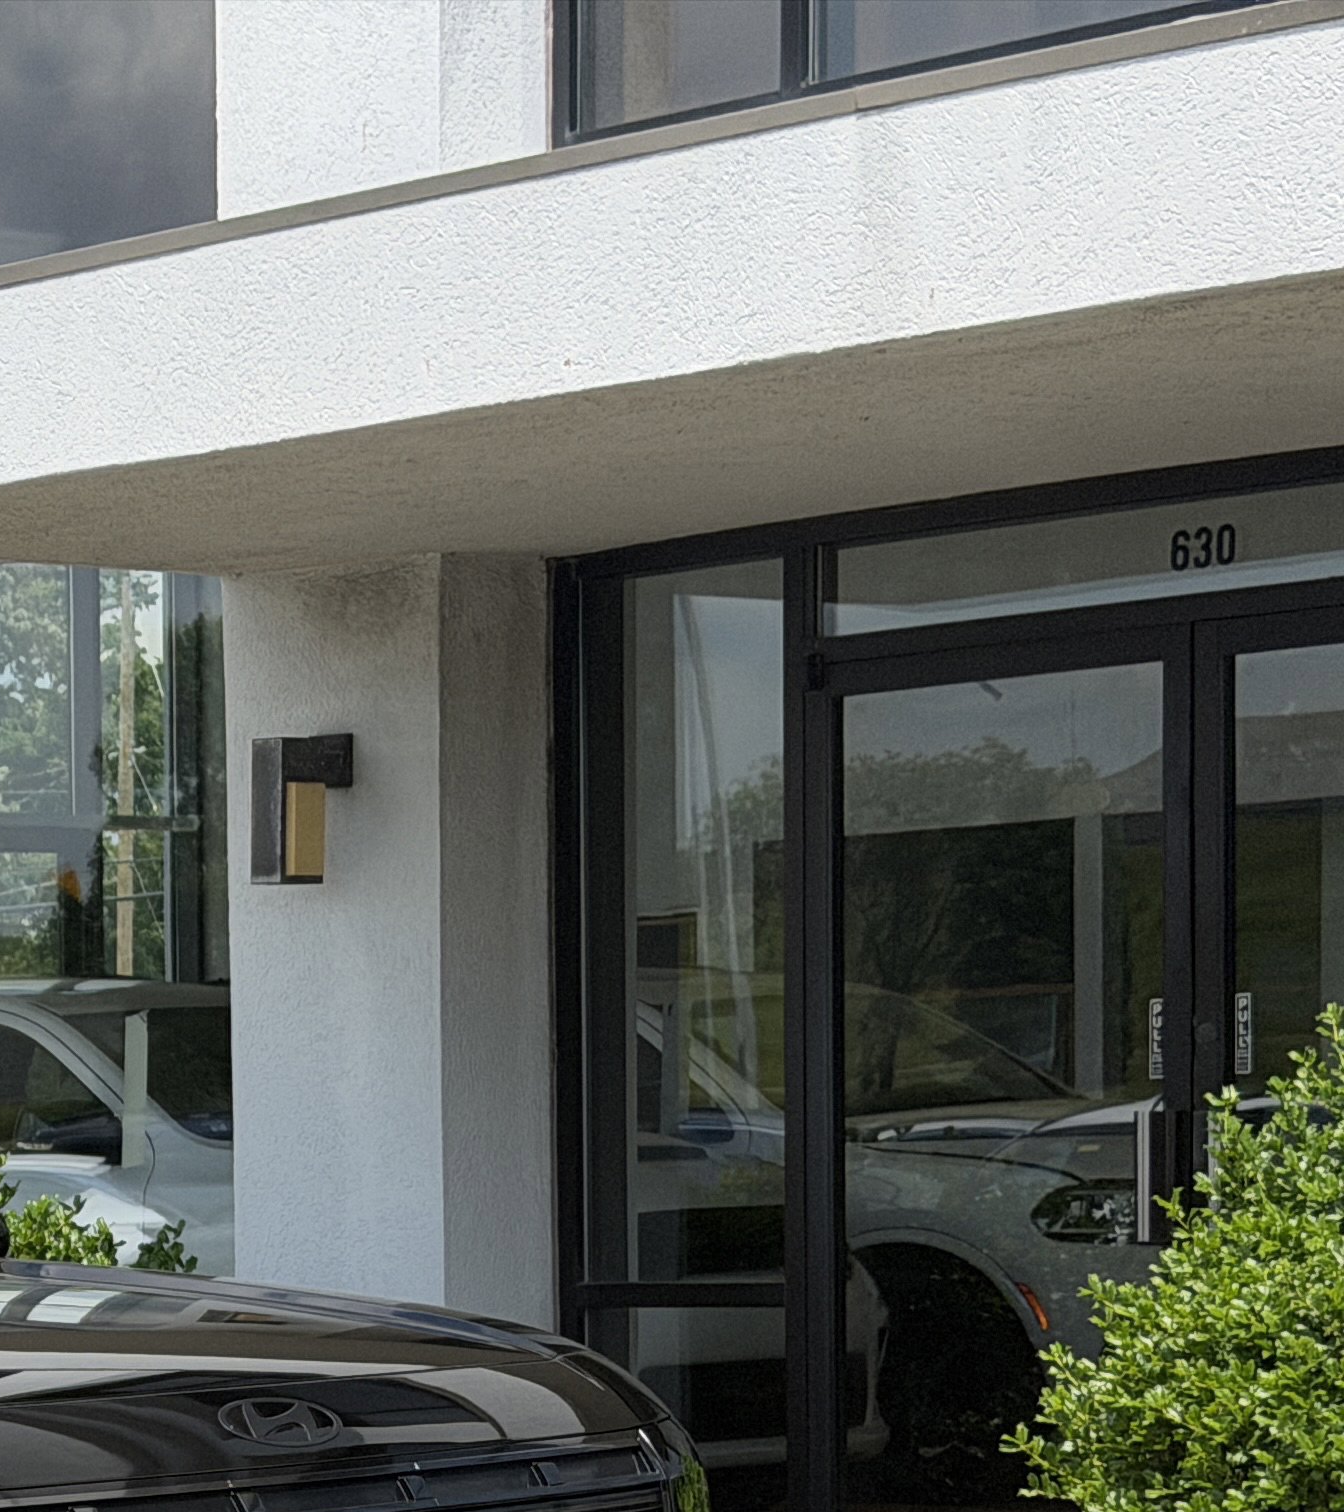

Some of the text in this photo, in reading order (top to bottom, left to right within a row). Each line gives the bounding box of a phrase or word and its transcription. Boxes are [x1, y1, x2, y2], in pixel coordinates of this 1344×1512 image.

[1171, 524, 1235, 571] 630
[1152, 1003, 1162, 1053] PULL
[1238, 998, 1248, 1048] PULL
